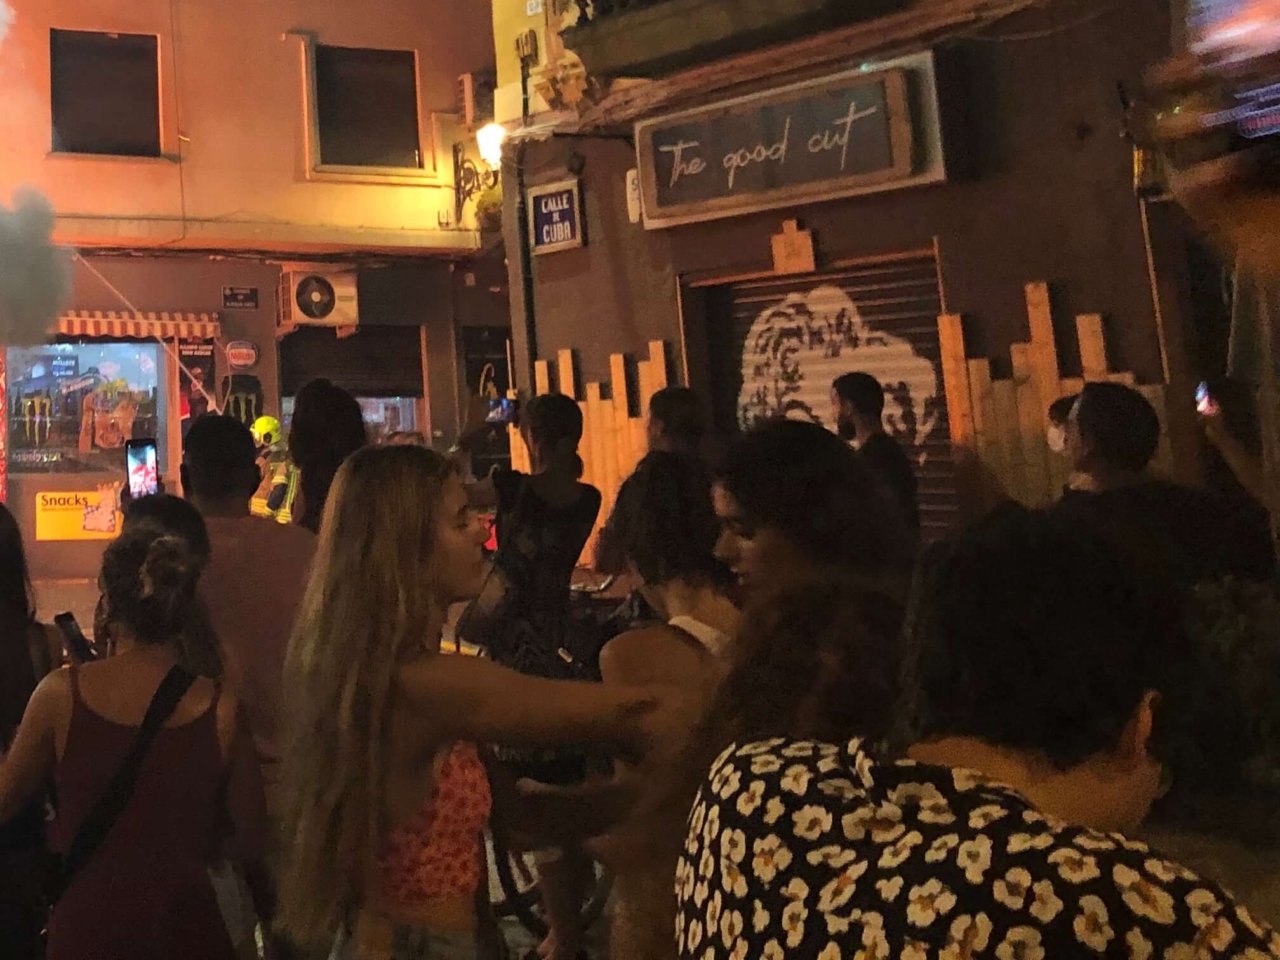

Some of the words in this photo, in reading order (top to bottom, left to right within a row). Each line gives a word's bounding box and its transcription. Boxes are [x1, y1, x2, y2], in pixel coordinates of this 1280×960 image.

[659, 140, 706, 189] The
[723, 115, 791, 189] good
[808, 102, 878, 170] cut
[541, 193, 570, 214] CALLE
[543, 221, 571, 243] CUBA
[41, 494, 88, 507] Snacks
